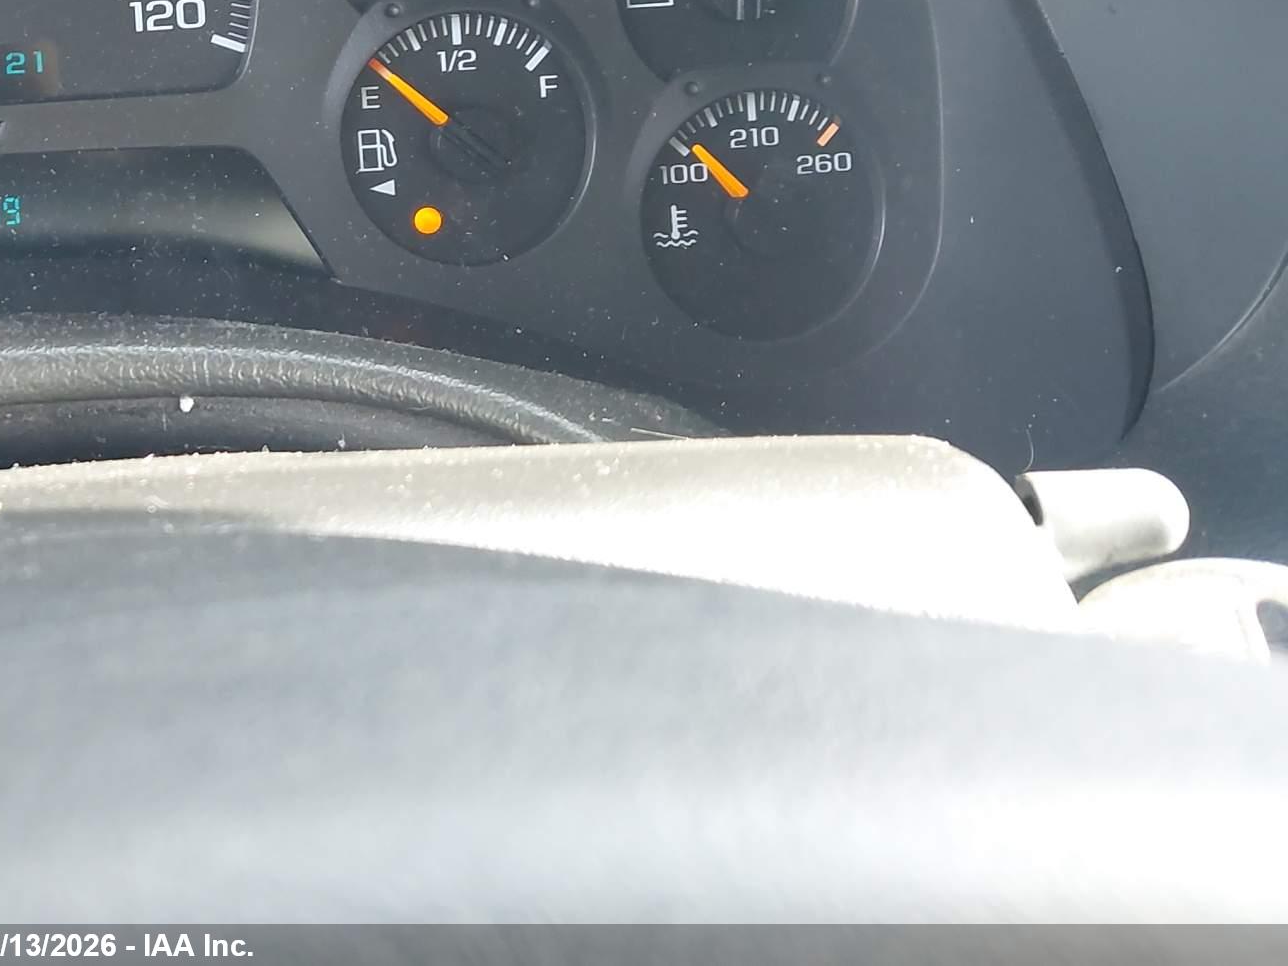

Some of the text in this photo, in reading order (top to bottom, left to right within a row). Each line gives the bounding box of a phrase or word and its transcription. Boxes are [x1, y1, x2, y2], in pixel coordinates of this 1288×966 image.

[437, 50, 476, 71] 1/2
[540, 75, 557, 97] F
[362, 87, 380, 108] E
[730, 127, 778, 148] 210
[660, 163, 708, 185] 100
[797, 153, 851, 174] 260
